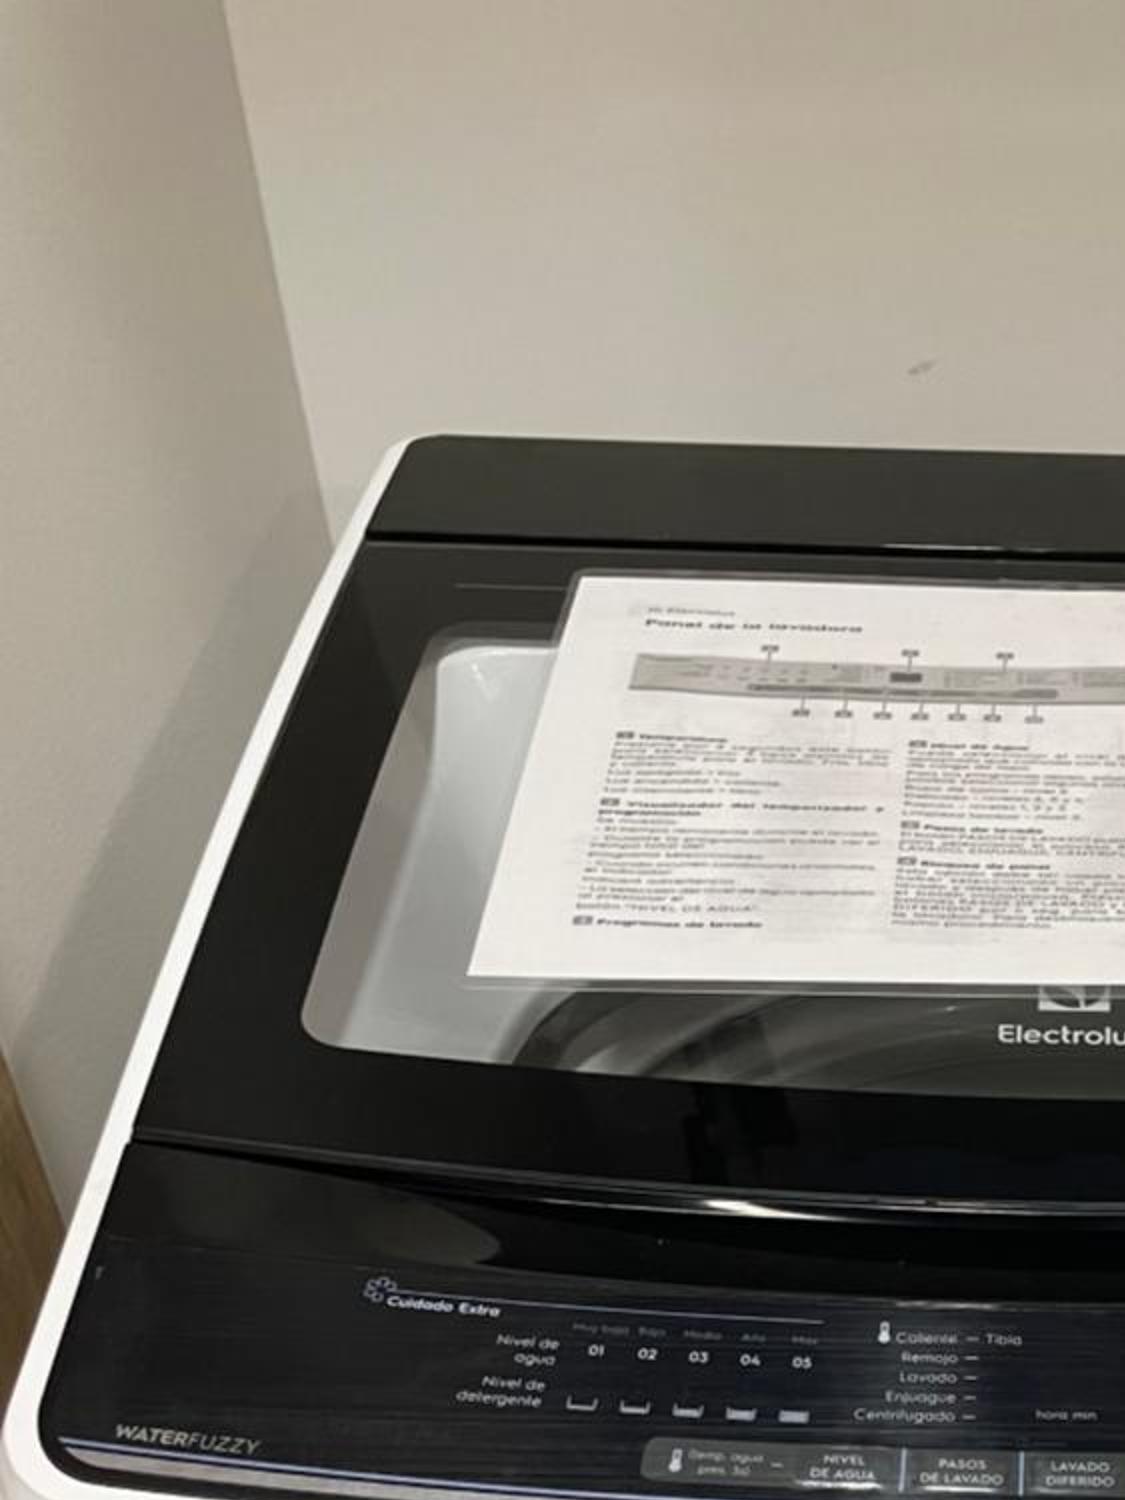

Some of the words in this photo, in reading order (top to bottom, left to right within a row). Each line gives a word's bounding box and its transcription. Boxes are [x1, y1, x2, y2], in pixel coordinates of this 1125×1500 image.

[387, 1295, 454, 1313] Cuidado
[458, 1302, 501, 1318] Extra
[496, 1333, 535, 1349] Nivel
[539, 1337, 560, 1351] de
[895, 1331, 958, 1345] Caliente
[986, 1332, 1023, 1346] Tibia
[587, 1343, 605, 1357] 01
[637, 1347, 659, 1361] 02
[513, 1353, 556, 1367] agua
[688, 1351, 710, 1364] 03
[739, 1353, 761, 1367] 04
[792, 1356, 813, 1369] 05
[901, 1351, 959, 1366] Remojo
[481, 1375, 522, 1390] Nivel
[525, 1379, 546, 1392] de
[900, 1371, 958, 1384] Lavado
[455, 1389, 542, 1408] detergente
[884, 1390, 957, 1406] Enjuague
[853, 1407, 956, 1425] Centrifugado
[1036, 1409, 1069, 1421] hora
[115, 1424, 263, 1455] WATERFUZZY
[823, 1453, 865, 1467] NIVEL
[937, 1457, 987, 1471] PASOS
[1050, 1459, 1111, 1474] LAVADO
[809, 1466, 832, 1480] DE
[834, 1467, 876, 1481] AGUA
[919, 1471, 945, 1484] DE
[947, 1471, 1004, 1486] LAVADO
[1045, 1474, 1116, 1489] DIFERIDO
